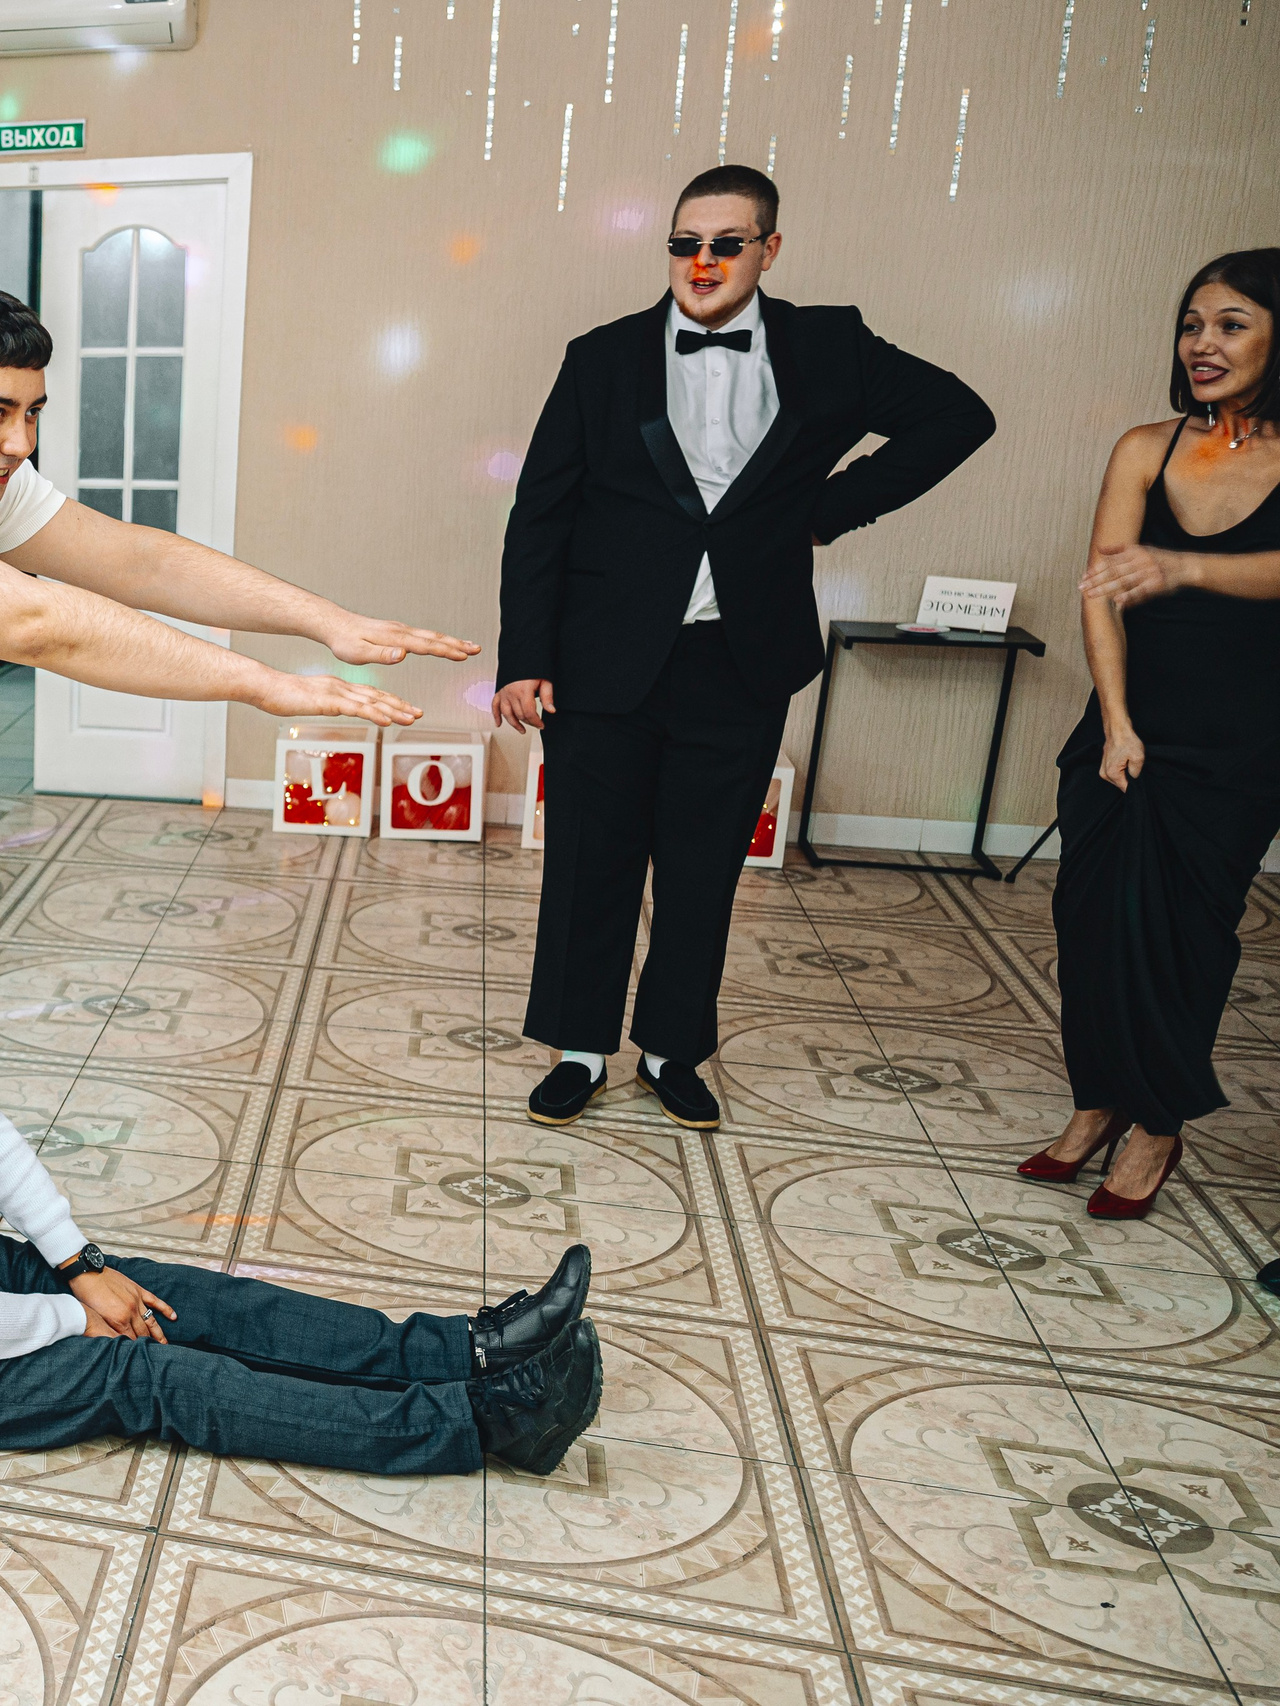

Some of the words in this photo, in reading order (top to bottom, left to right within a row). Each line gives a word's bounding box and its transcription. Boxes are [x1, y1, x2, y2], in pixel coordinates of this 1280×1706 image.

[1, 126, 77, 148] ВЫХОД
[923, 600, 954, 612] ЭТО
[956, 603, 1006, 618] МЕЗИМ
